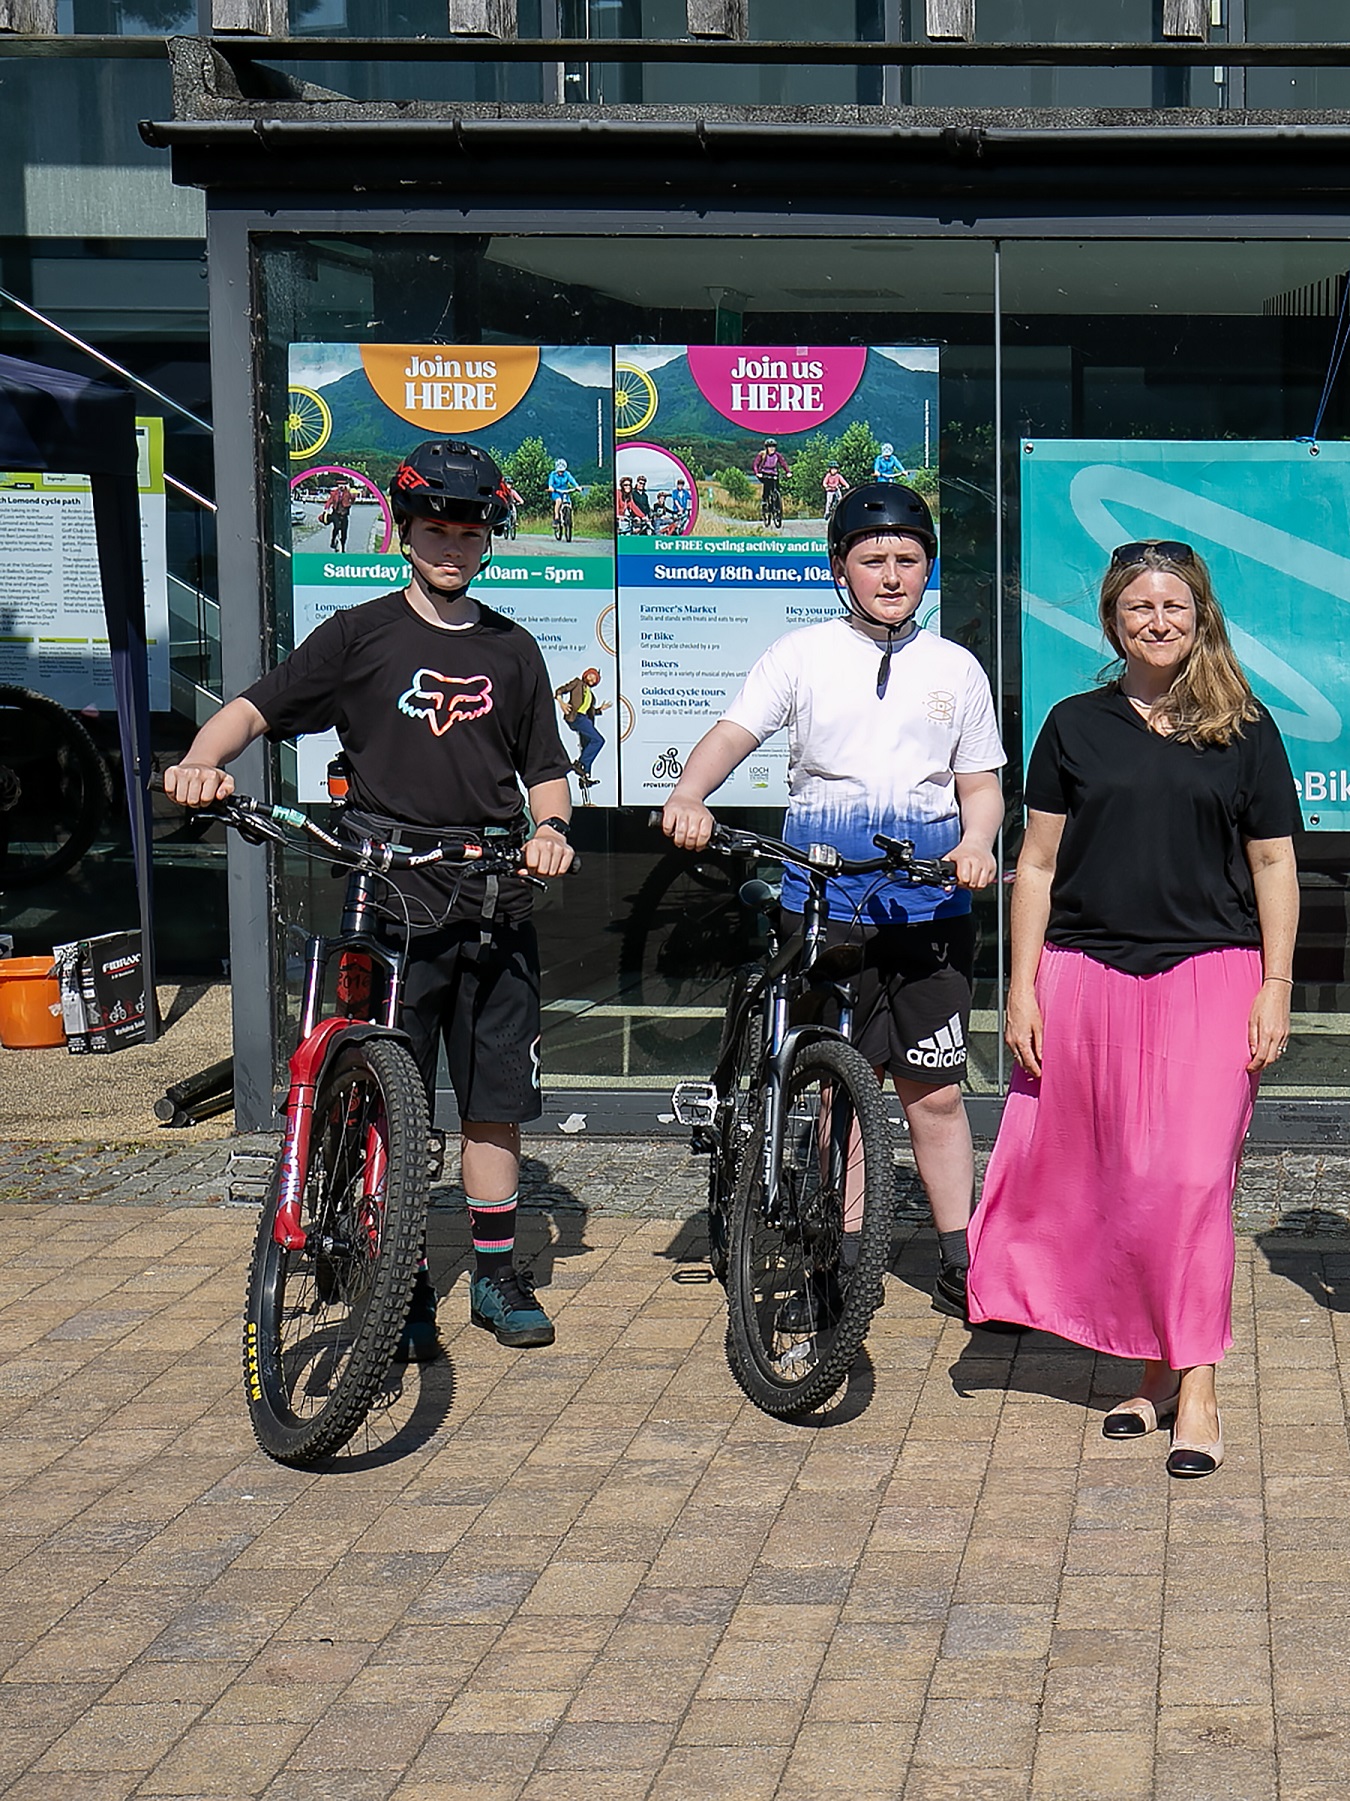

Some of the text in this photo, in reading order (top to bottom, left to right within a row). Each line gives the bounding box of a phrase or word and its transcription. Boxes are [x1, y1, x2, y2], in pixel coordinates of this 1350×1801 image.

[405, 355, 497, 378] Join us
[731, 356, 824, 379] Join us
[405, 382, 497, 410] HERE
[731, 383, 824, 411] HERE
[41, 497, 61, 506] cycle
[62, 498, 82, 506] path
[654, 540, 674, 550] For
[675, 540, 703, 551] FREE
[704, 540, 745, 553] cycling
[746, 541, 785, 553] activity
[787, 541, 809, 552] and
[324, 563, 400, 581] Saturday
[485, 566, 529, 580] 10am
[544, 566, 584, 583] 5pm
[654, 564, 834, 583] Sunday 18th June, 10a
[495, 606, 516, 615] afety
[640, 604, 717, 613] Farmer's Market
[786, 606, 803, 616] Hey
[805, 608, 823, 616] you
[824, 608, 837, 616] up
[536, 633, 562, 642] sions
[641, 632, 674, 641] Dr Bike
[641, 660, 680, 668] Buskers
[642, 688, 726, 697] Guided cycle tours
[642, 699, 711, 707] to Balloch Park
[749, 766, 769, 774] LOCH
[906, 1047, 967, 1068] adidas
[248, 1322, 262, 1401] MAXXIS
